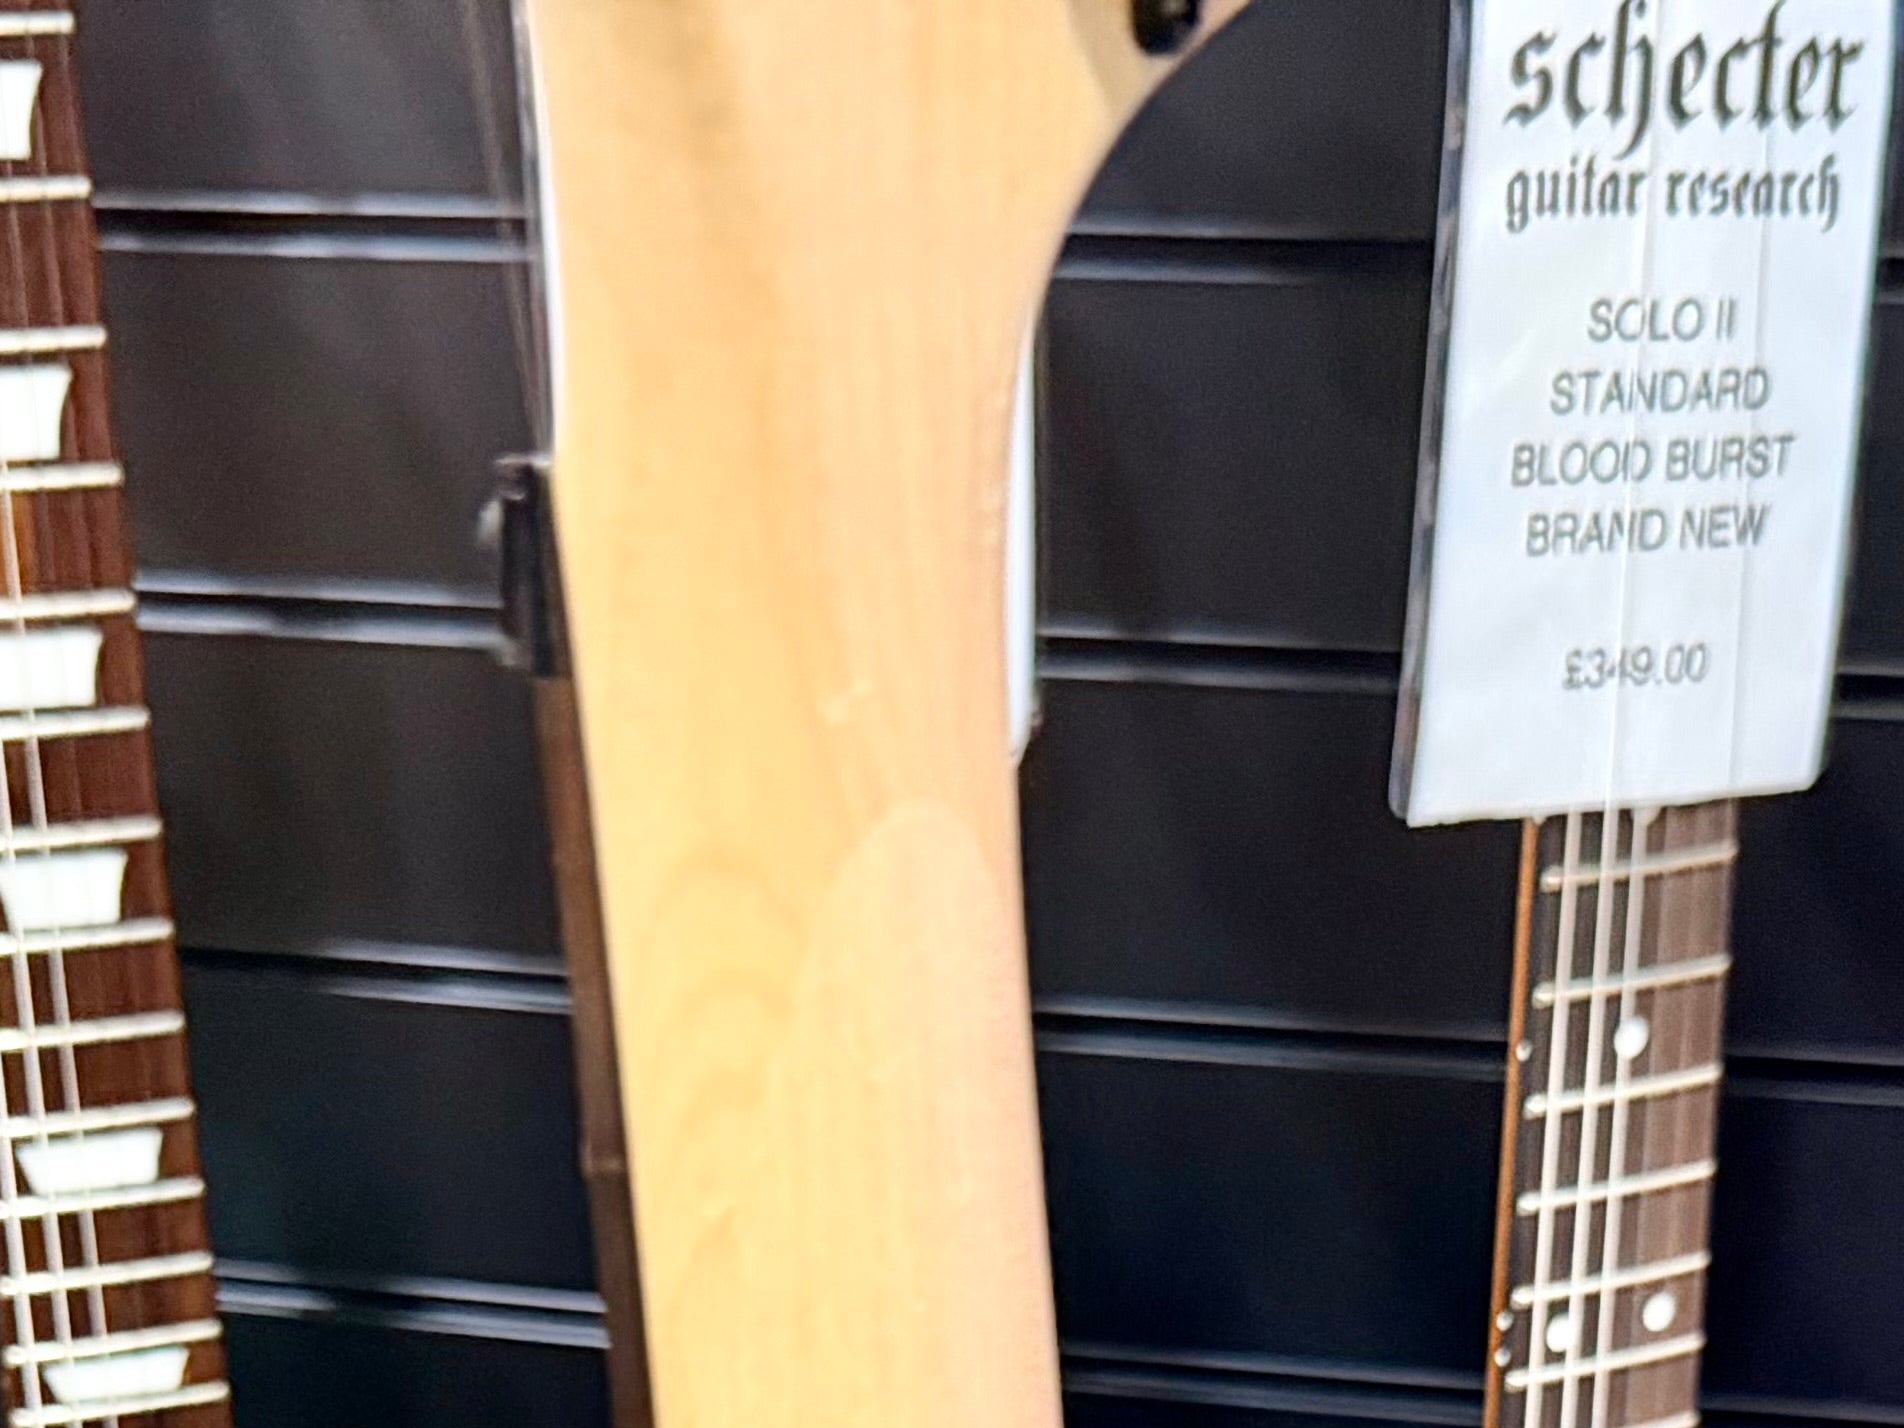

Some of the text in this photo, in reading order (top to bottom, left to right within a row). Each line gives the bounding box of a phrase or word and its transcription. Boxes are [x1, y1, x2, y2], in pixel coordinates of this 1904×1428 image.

[1502, 0, 1866, 160] schecter
[1506, 150, 1840, 234] guitar research
[1587, 297, 1705, 343] SOLO
[1550, 370, 1772, 416] STANDARD
[1511, 435, 1796, 487] BLOOD BURST
[1525, 506, 1773, 557] BRAND NEW
[1562, 642, 1708, 691] £349.00
